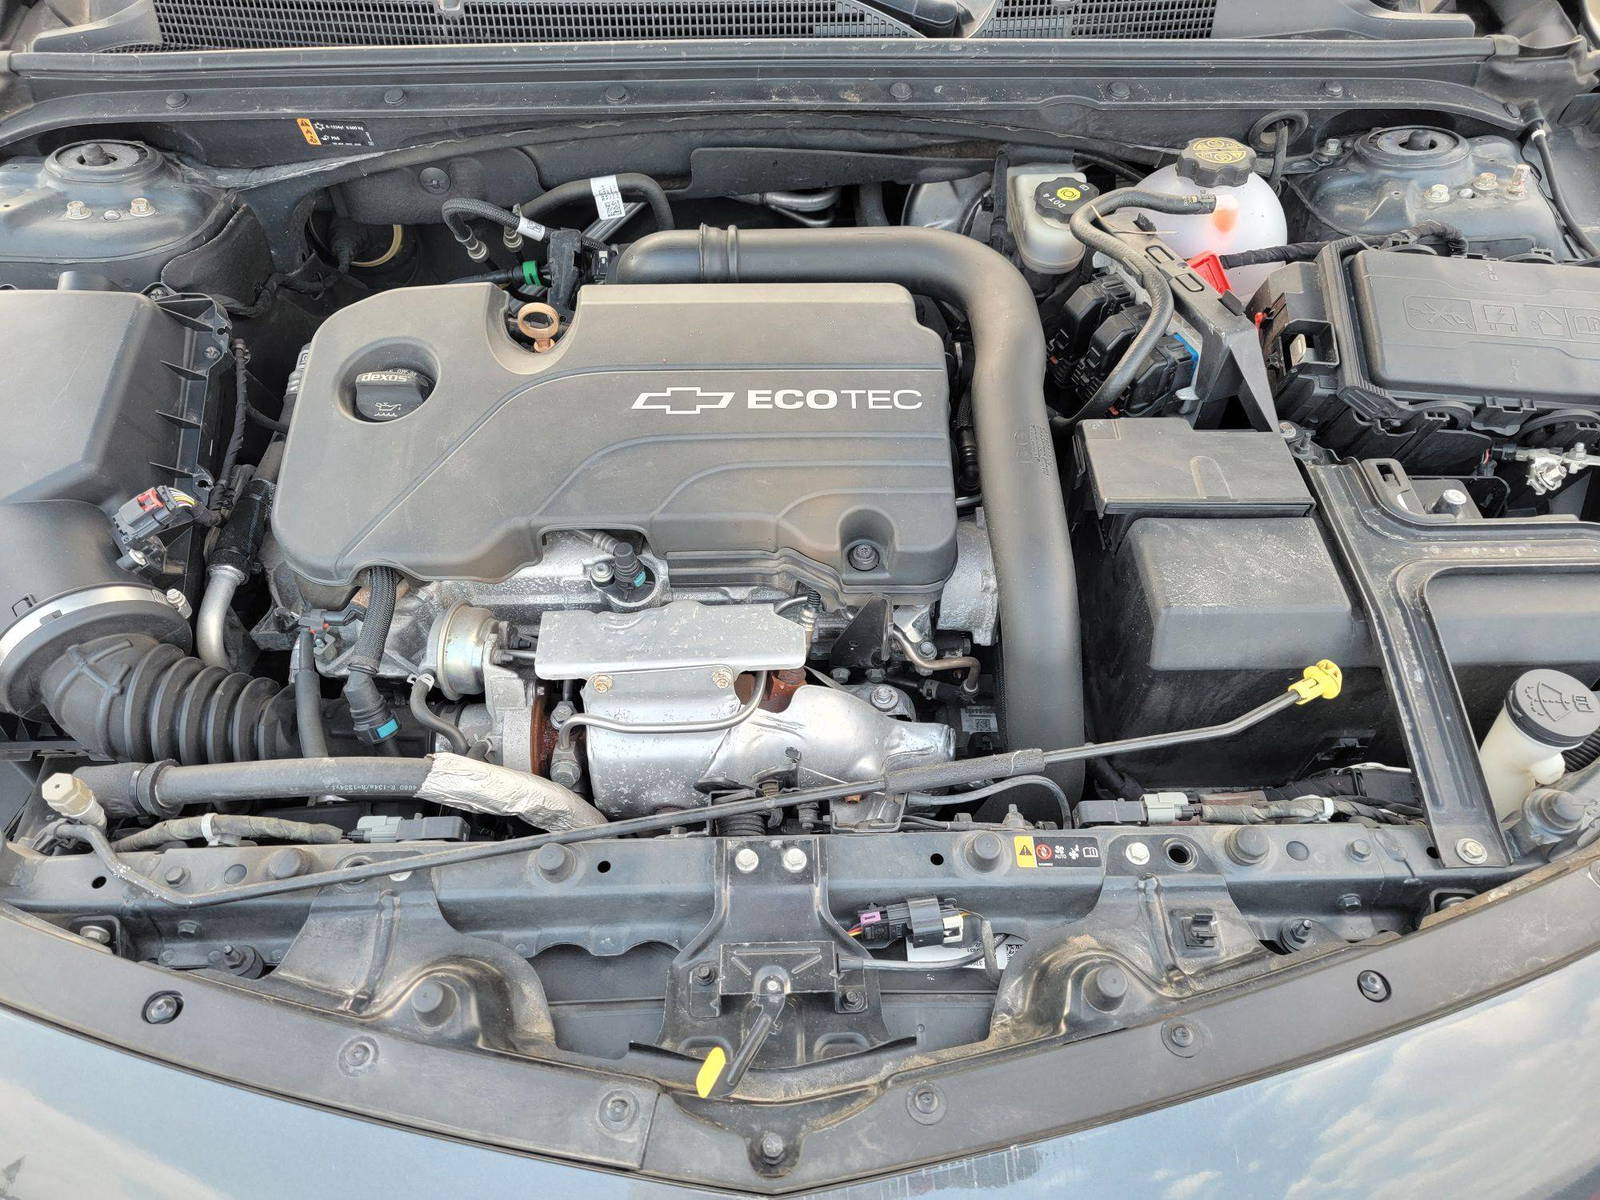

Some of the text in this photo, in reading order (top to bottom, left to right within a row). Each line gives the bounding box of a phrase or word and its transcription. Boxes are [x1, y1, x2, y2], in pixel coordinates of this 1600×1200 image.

[1048, 197, 1067, 209] DOT
[361, 372, 408, 382] dexos
[747, 389, 923, 410] ECOTEC
